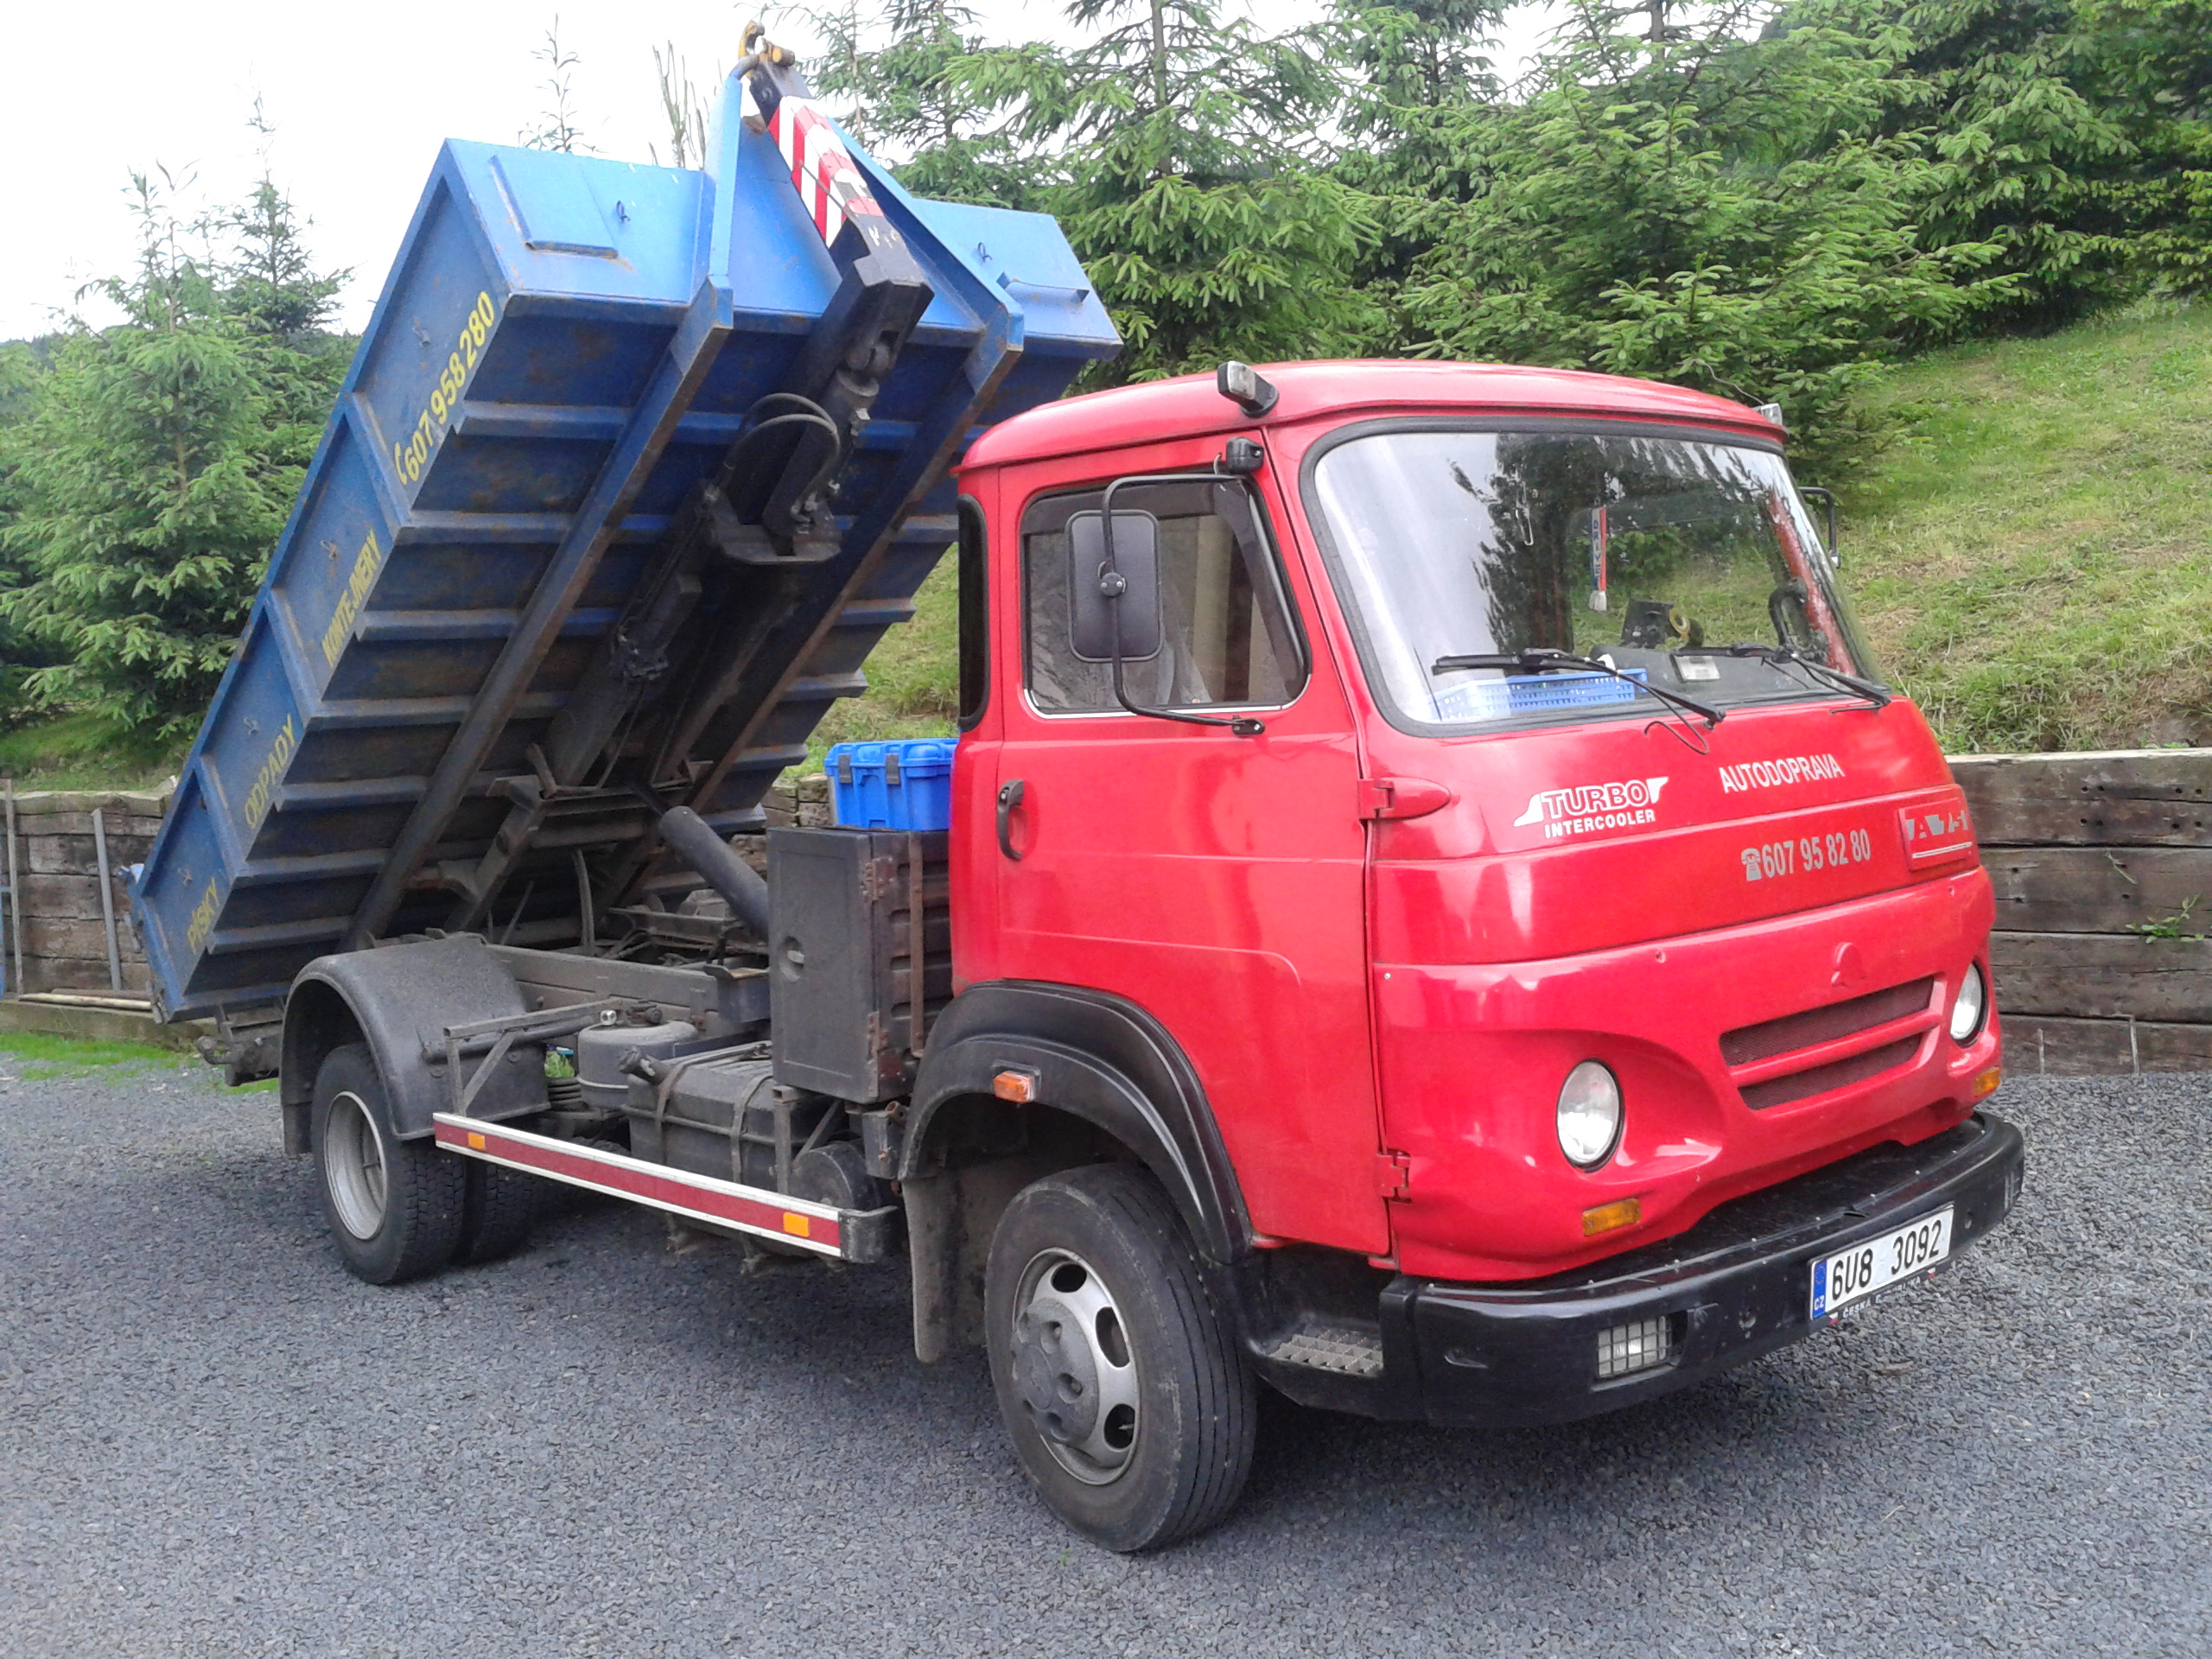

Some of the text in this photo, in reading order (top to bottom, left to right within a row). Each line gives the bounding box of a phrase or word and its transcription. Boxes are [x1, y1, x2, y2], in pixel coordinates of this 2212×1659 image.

[430, 352, 467, 424] 958
[459, 290, 495, 369] 280
[245, 713, 295, 829] ODPADY
[1719, 753, 1845, 793] AUTODOPRAVA
[1541, 779, 1649, 819] TURBO
[1544, 809, 1656, 839] INTERCOOLER
[1761, 828, 1872, 878] 607 95 82 80
[1832, 1219, 1942, 1300] 6U8 3092
[1815, 1295, 1825, 1311] CZ
